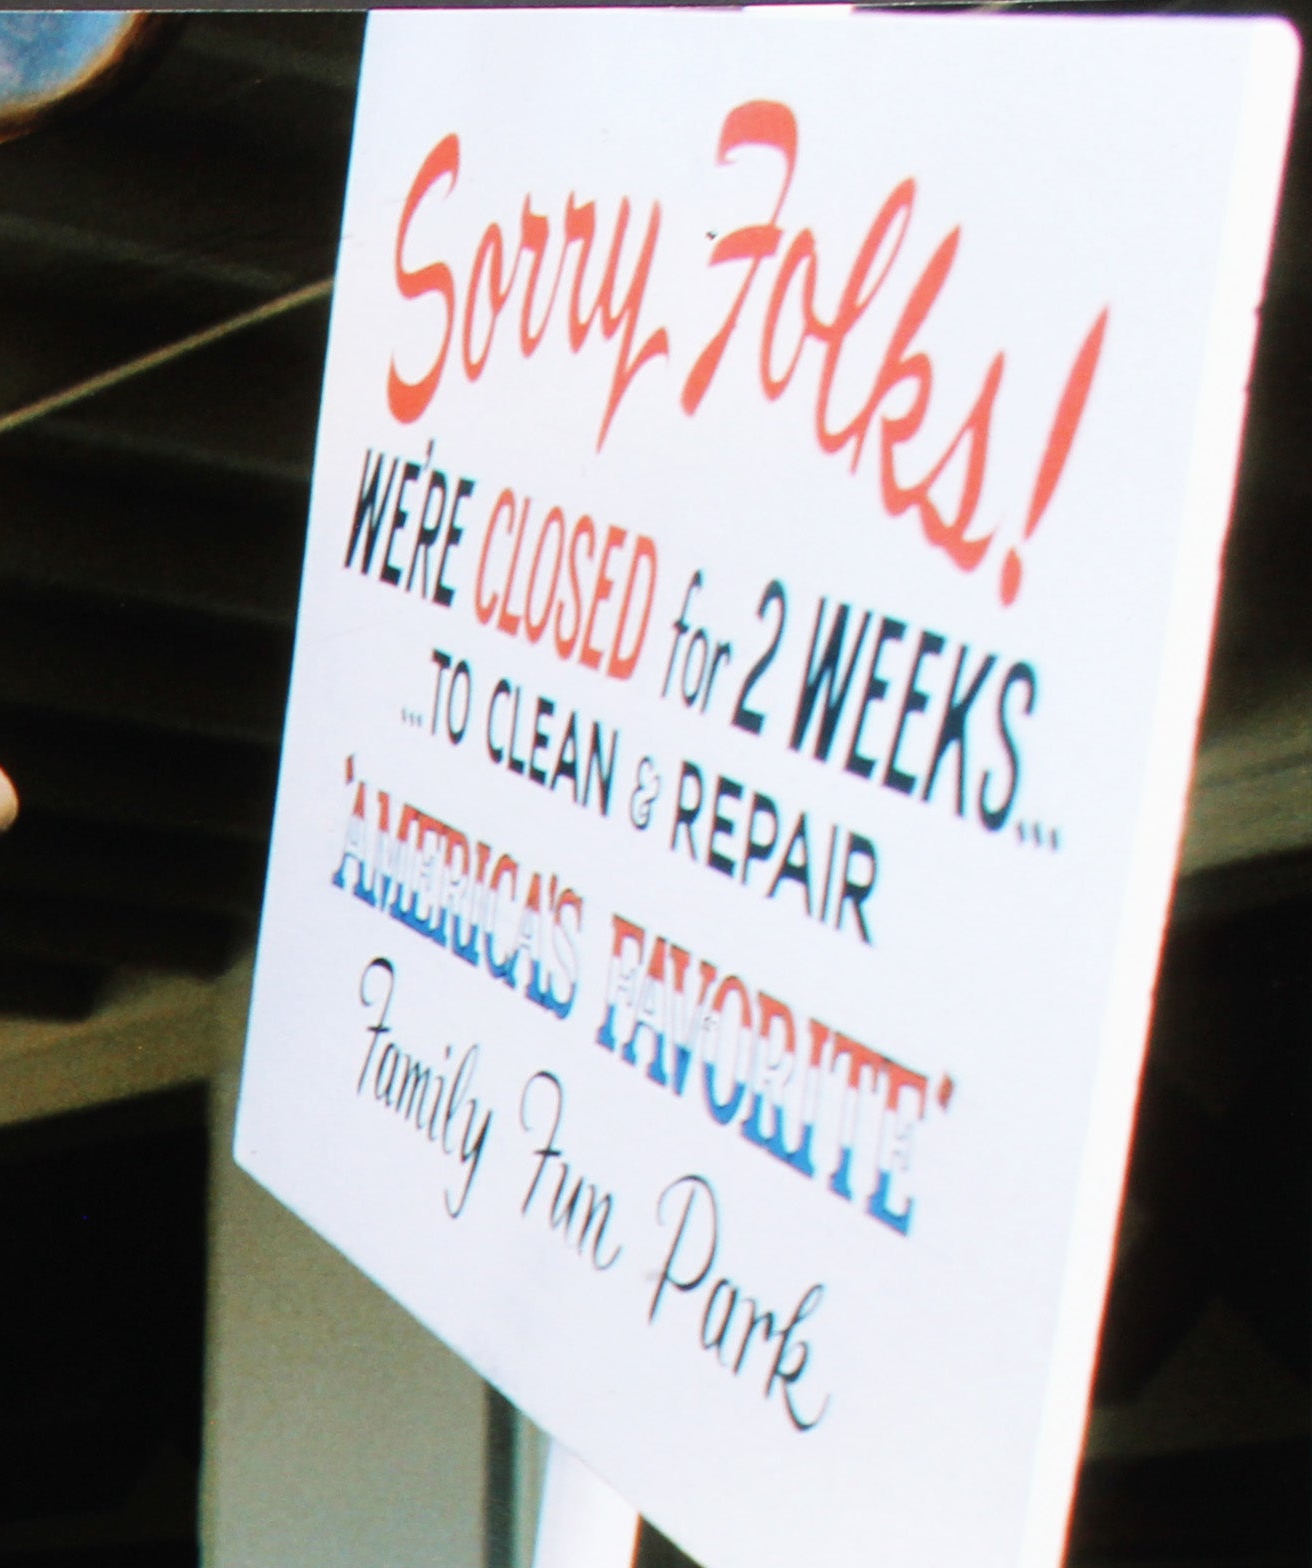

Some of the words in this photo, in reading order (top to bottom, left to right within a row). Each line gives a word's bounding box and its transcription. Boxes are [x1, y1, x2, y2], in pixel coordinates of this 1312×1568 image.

[387, 133, 669, 453] Sorry
[681, 99, 1110, 609] Folks!
[342, 439, 475, 608] WE'RE
[473, 488, 659, 681] CLOSED
[661, 570, 731, 712] for
[732, 579, 789, 736] 2
[486, 677, 621, 818] CLEAN
[629, 755, 660, 832] &
[671, 760, 879, 946] REPAIR
[356, 957, 494, 1219] Family
[519, 1070, 622, 1270] Fun
[649, 1174, 830, 1432] Park
